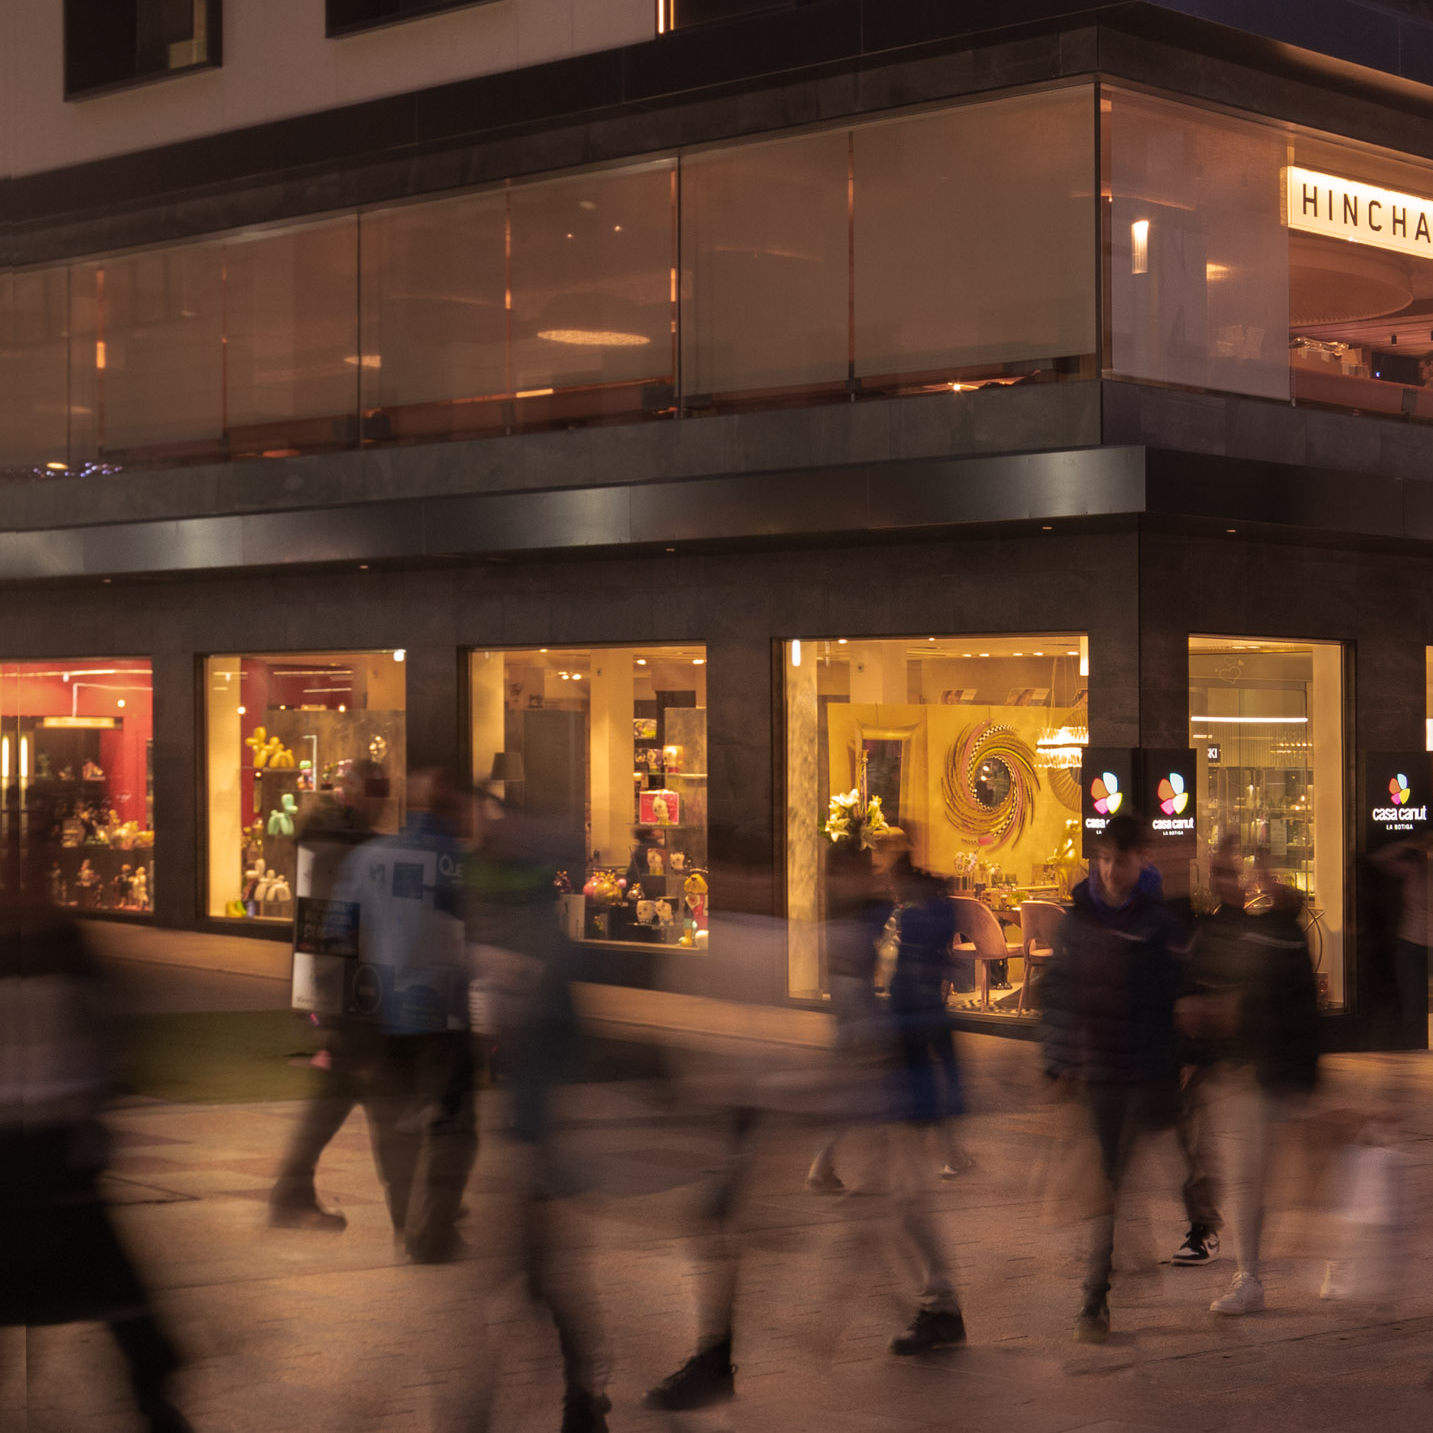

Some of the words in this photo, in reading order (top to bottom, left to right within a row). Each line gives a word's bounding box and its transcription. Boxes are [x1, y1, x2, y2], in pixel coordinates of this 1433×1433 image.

[1302, 183, 1432, 244] HINCHA
[1372, 807, 1398, 821] casa
[1398, 805, 1427, 821] canut
[1085, 818, 1106, 829] casa
[1152, 819, 1173, 830] casa
[1173, 817, 1195, 830] canut
